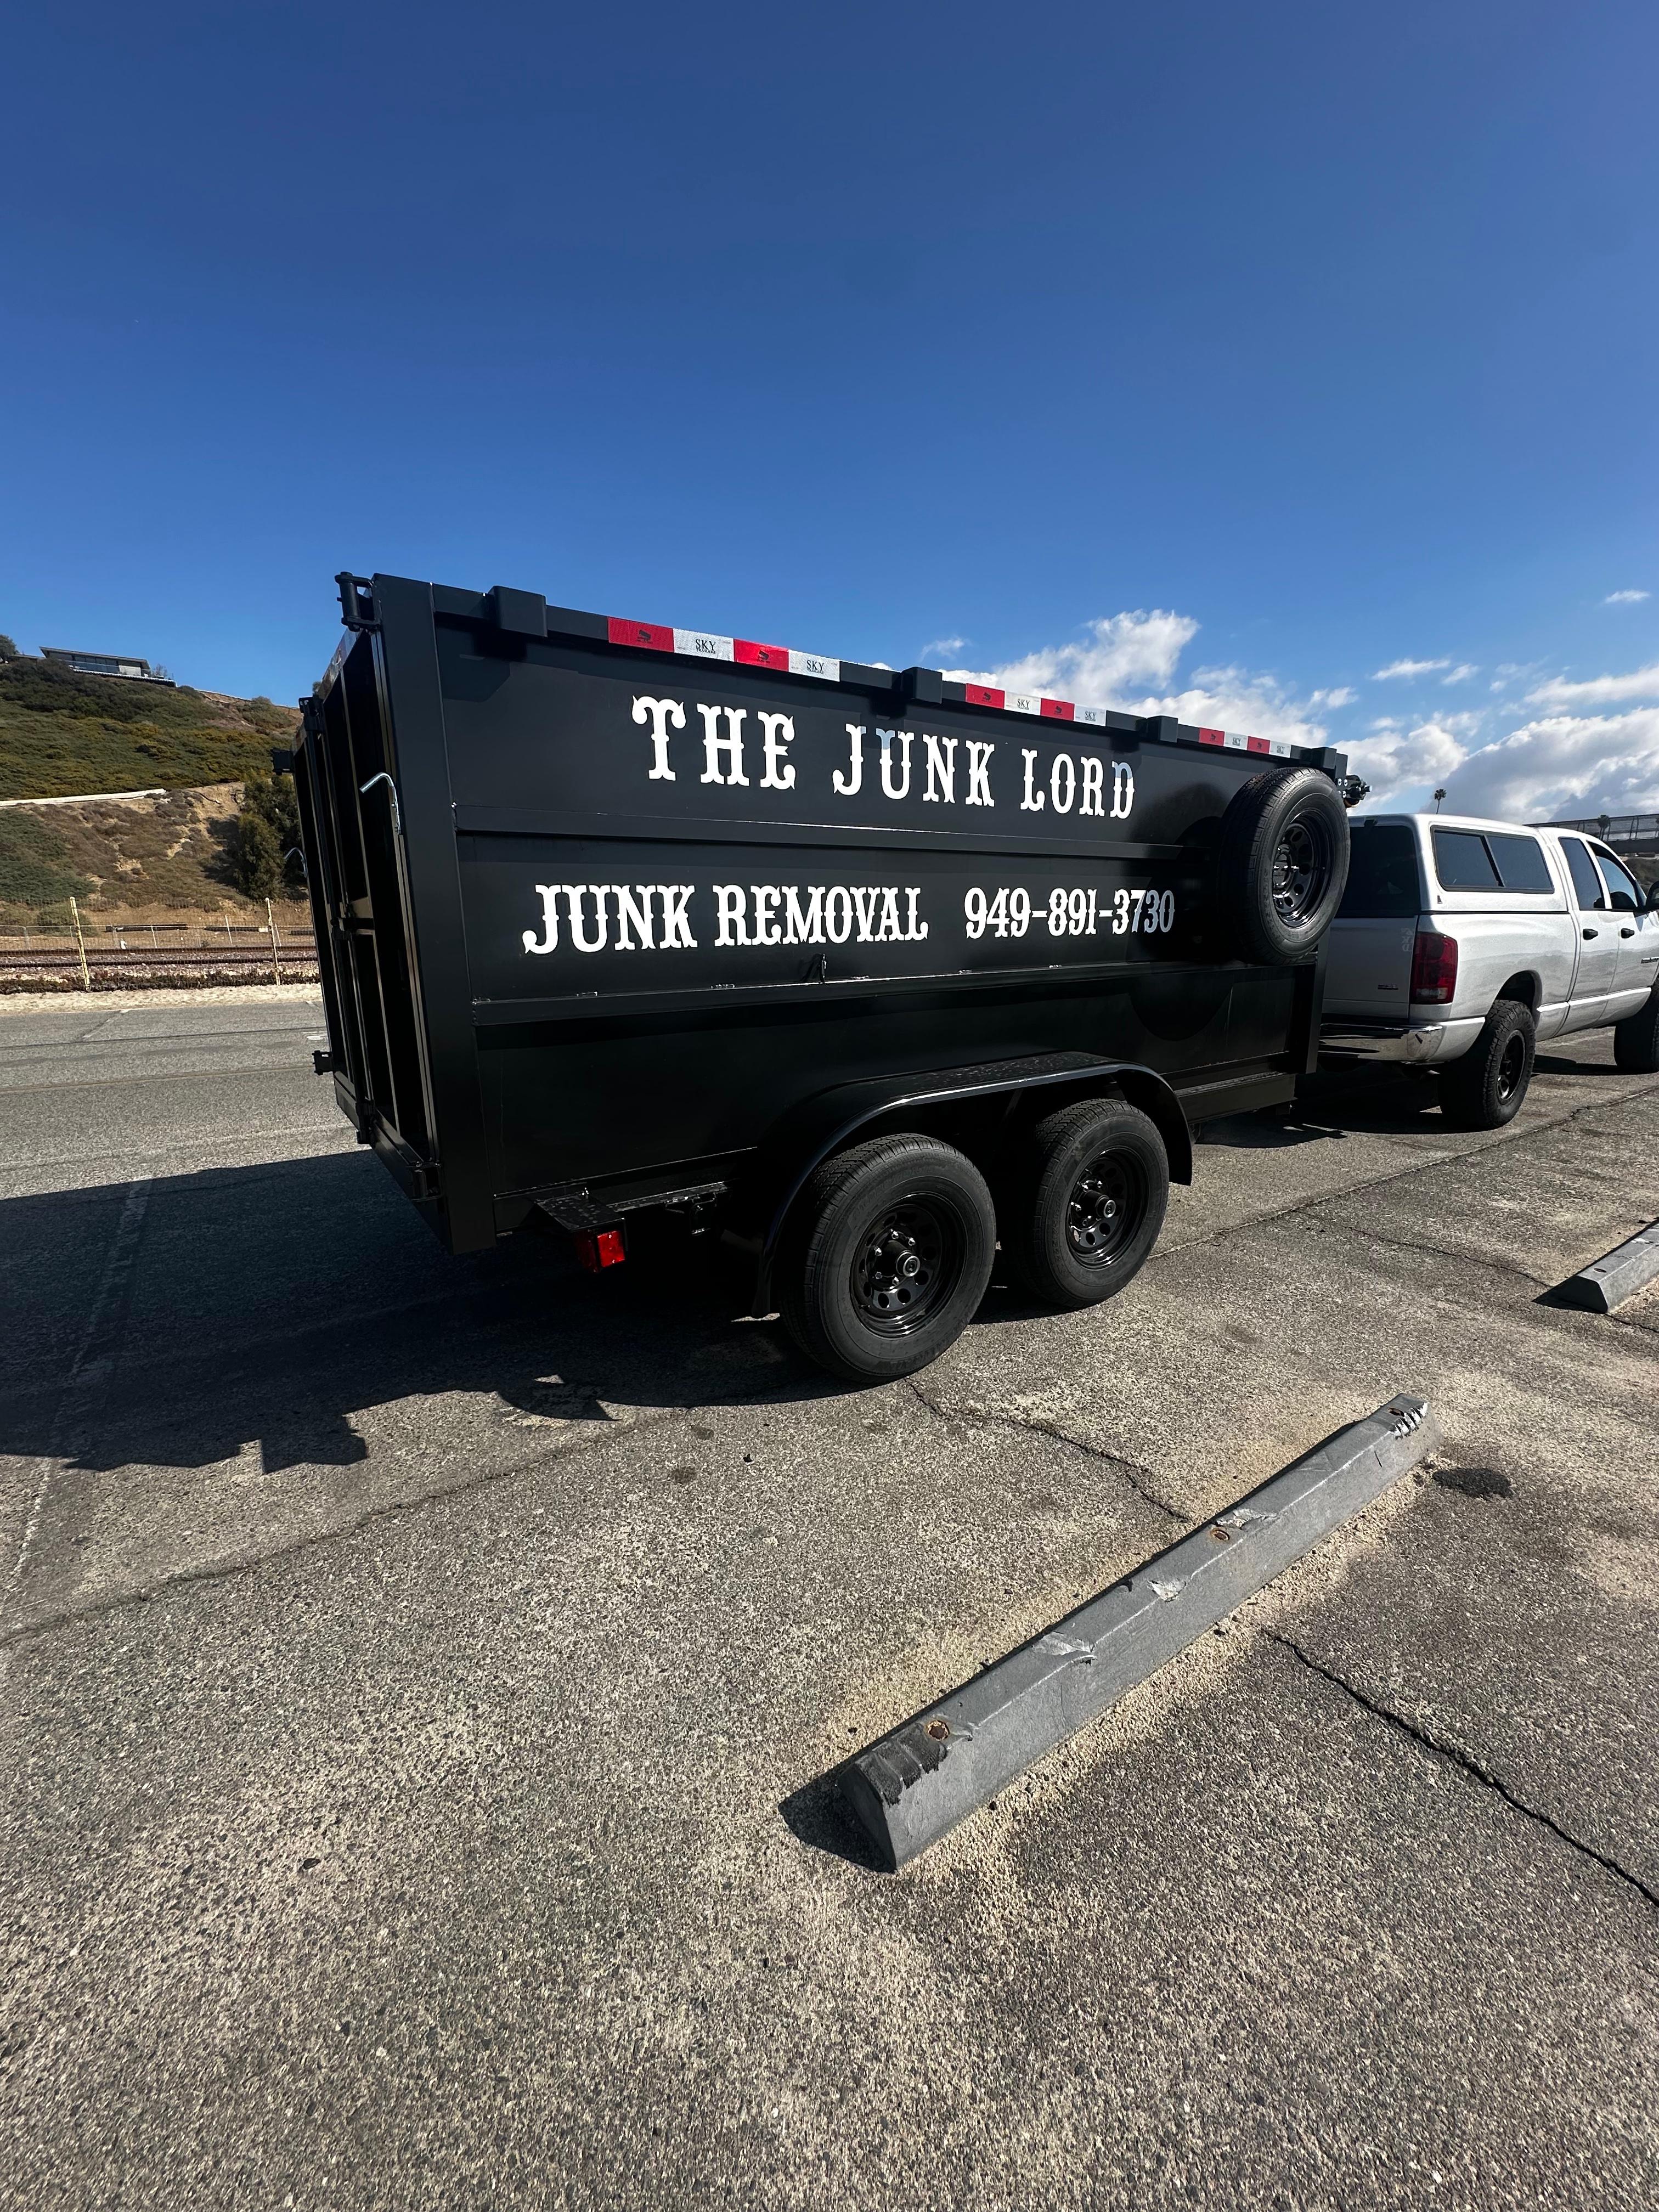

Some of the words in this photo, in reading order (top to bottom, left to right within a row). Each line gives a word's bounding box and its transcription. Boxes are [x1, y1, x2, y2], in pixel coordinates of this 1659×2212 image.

[695, 638, 715, 651] SKY
[806, 660, 824, 671] SKY
[1017, 698, 1030, 709] SKY
[1085, 711, 1097, 719] SKY
[631, 695, 796, 790] THE
[832, 723, 995, 807] JUNK
[1020, 748, 1135, 819] LORD
[522, 884, 698, 955] JUNK
[712, 884, 929, 947] REMOVAL
[964, 887, 1175, 939] 949-891-3730
